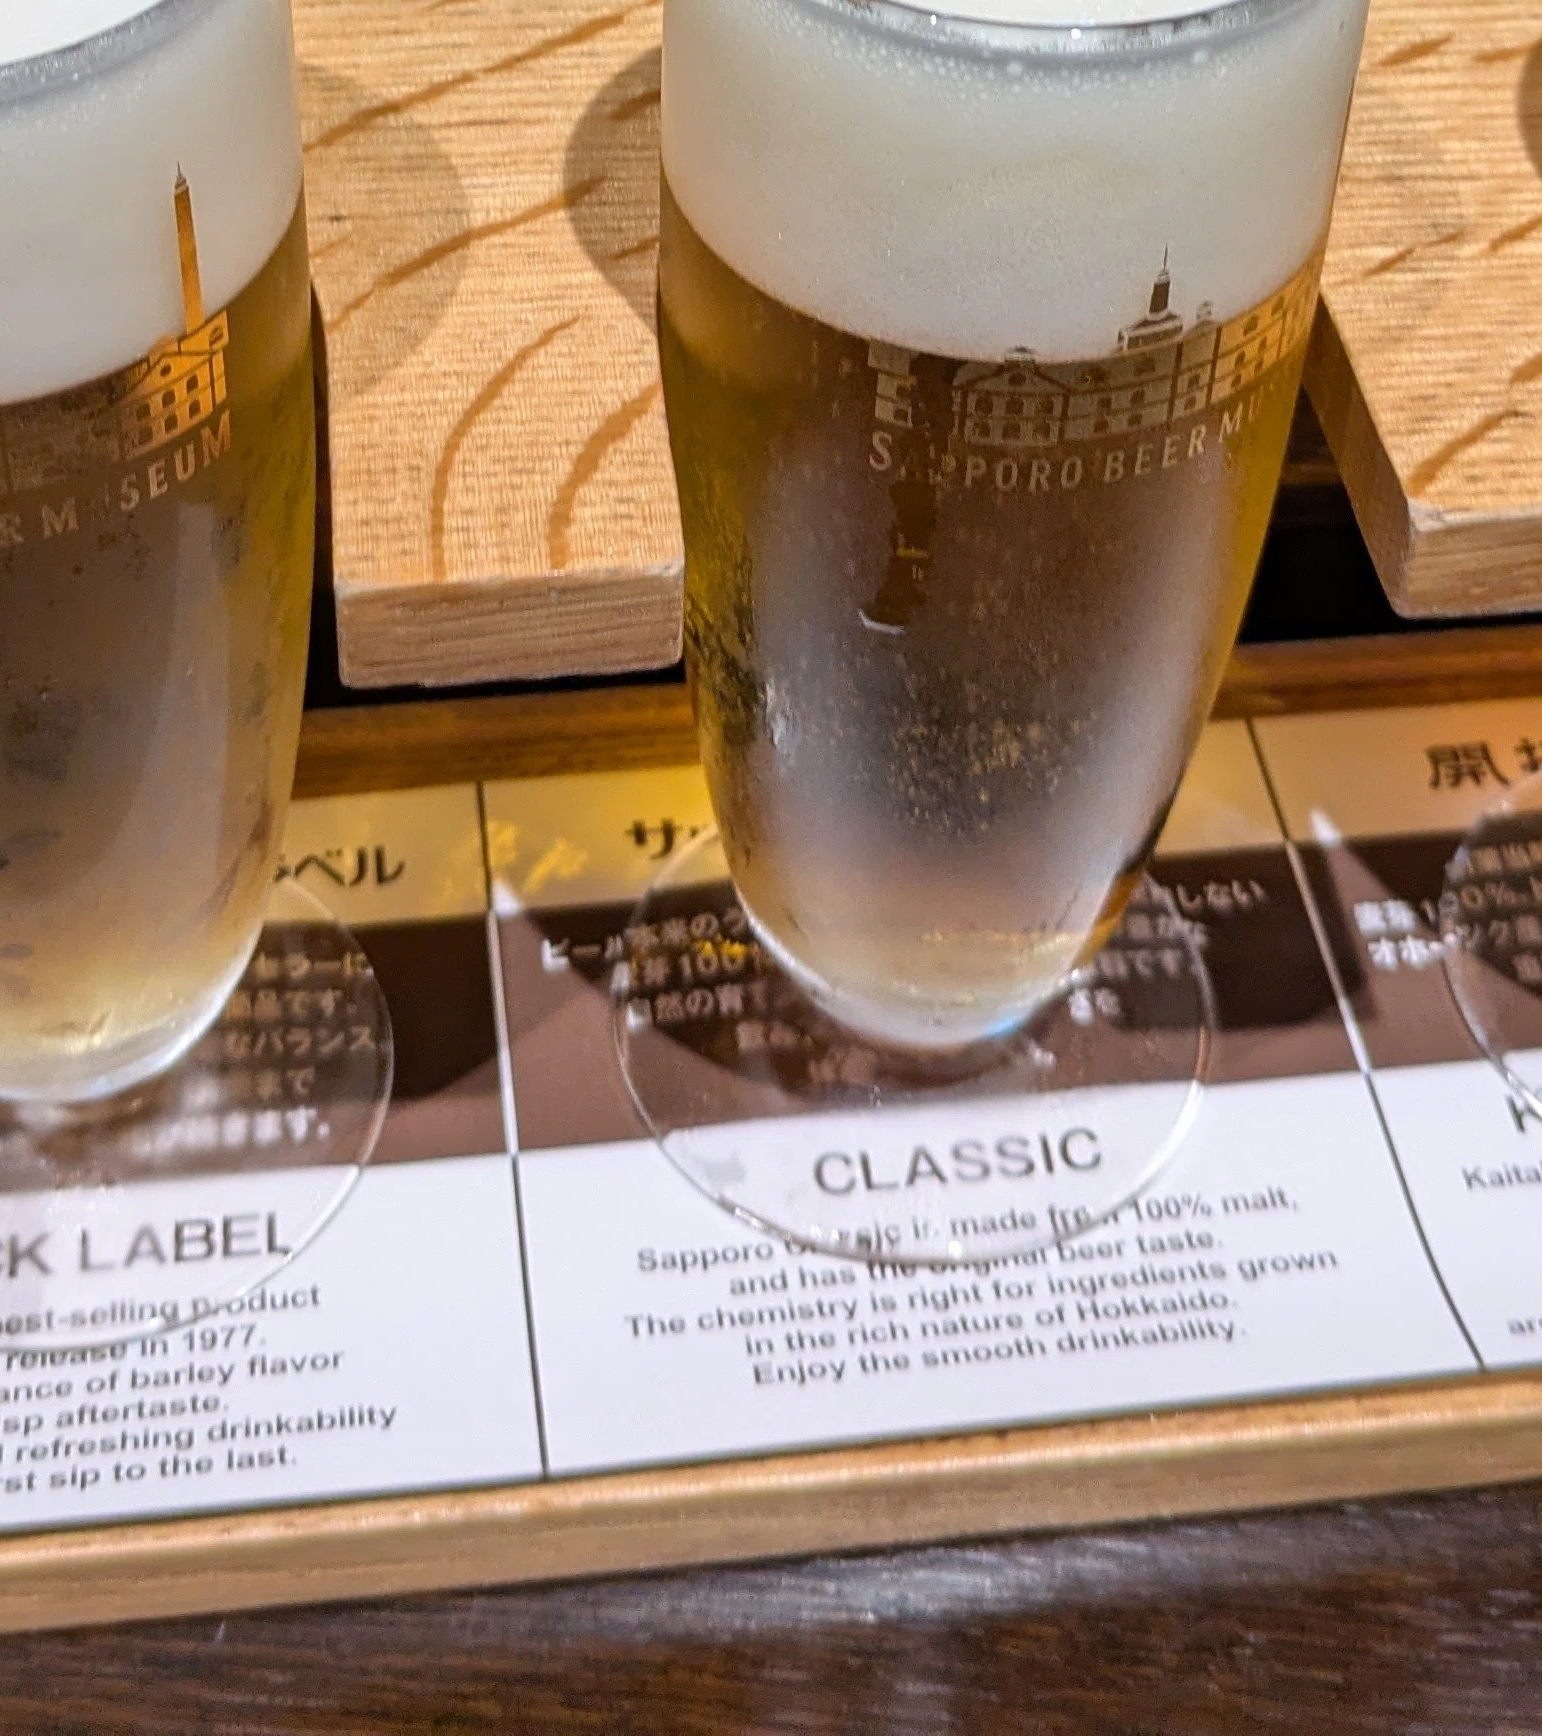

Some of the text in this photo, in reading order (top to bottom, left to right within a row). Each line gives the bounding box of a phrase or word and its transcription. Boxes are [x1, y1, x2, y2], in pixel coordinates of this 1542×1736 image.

[41, 409, 233, 541] MSEUM
[869, 429, 1084, 494] SPORO
[1103, 424, 1207, 485] BEER
[813, 1126, 1102, 1197] CLASSIC
[78, 1211, 293, 1274] LABEL
[636, 1241, 774, 1274] Sapporo
[949, 1206, 1037, 1237] made
[1131, 1191, 1212, 1223] 100%
[1221, 1184, 1299, 1215] malt,
[729, 1267, 789, 1297] and
[799, 1265, 857, 1290] has
[1057, 1238, 1126, 1263] beer
[1135, 1227, 1224, 1256] taste.
[625, 1249, 1339, 1338] The chemistry is right for ingredients grown
[745, 1289, 1238, 1357] in the rich nature of Hokkaido.
[85, 1369, 123, 1396] of
[130, 1361, 236, 1391] barley
[248, 1349, 346, 1378] flavor
[140, 1337, 169, 1357] in
[183, 1323, 267, 1353] 1977.
[753, 1318, 1247, 1387] Enjoy the smooth drinkability.
[15, 1426, 196, 1463] refreshing
[206, 1404, 398, 1443] drinkability
[55, 1390, 229, 1429] aftertaste.
[49, 1463, 101, 1491] sip
[112, 1461, 148, 1484] to
[158, 1453, 214, 1479] the
[226, 1443, 297, 1472] last.
